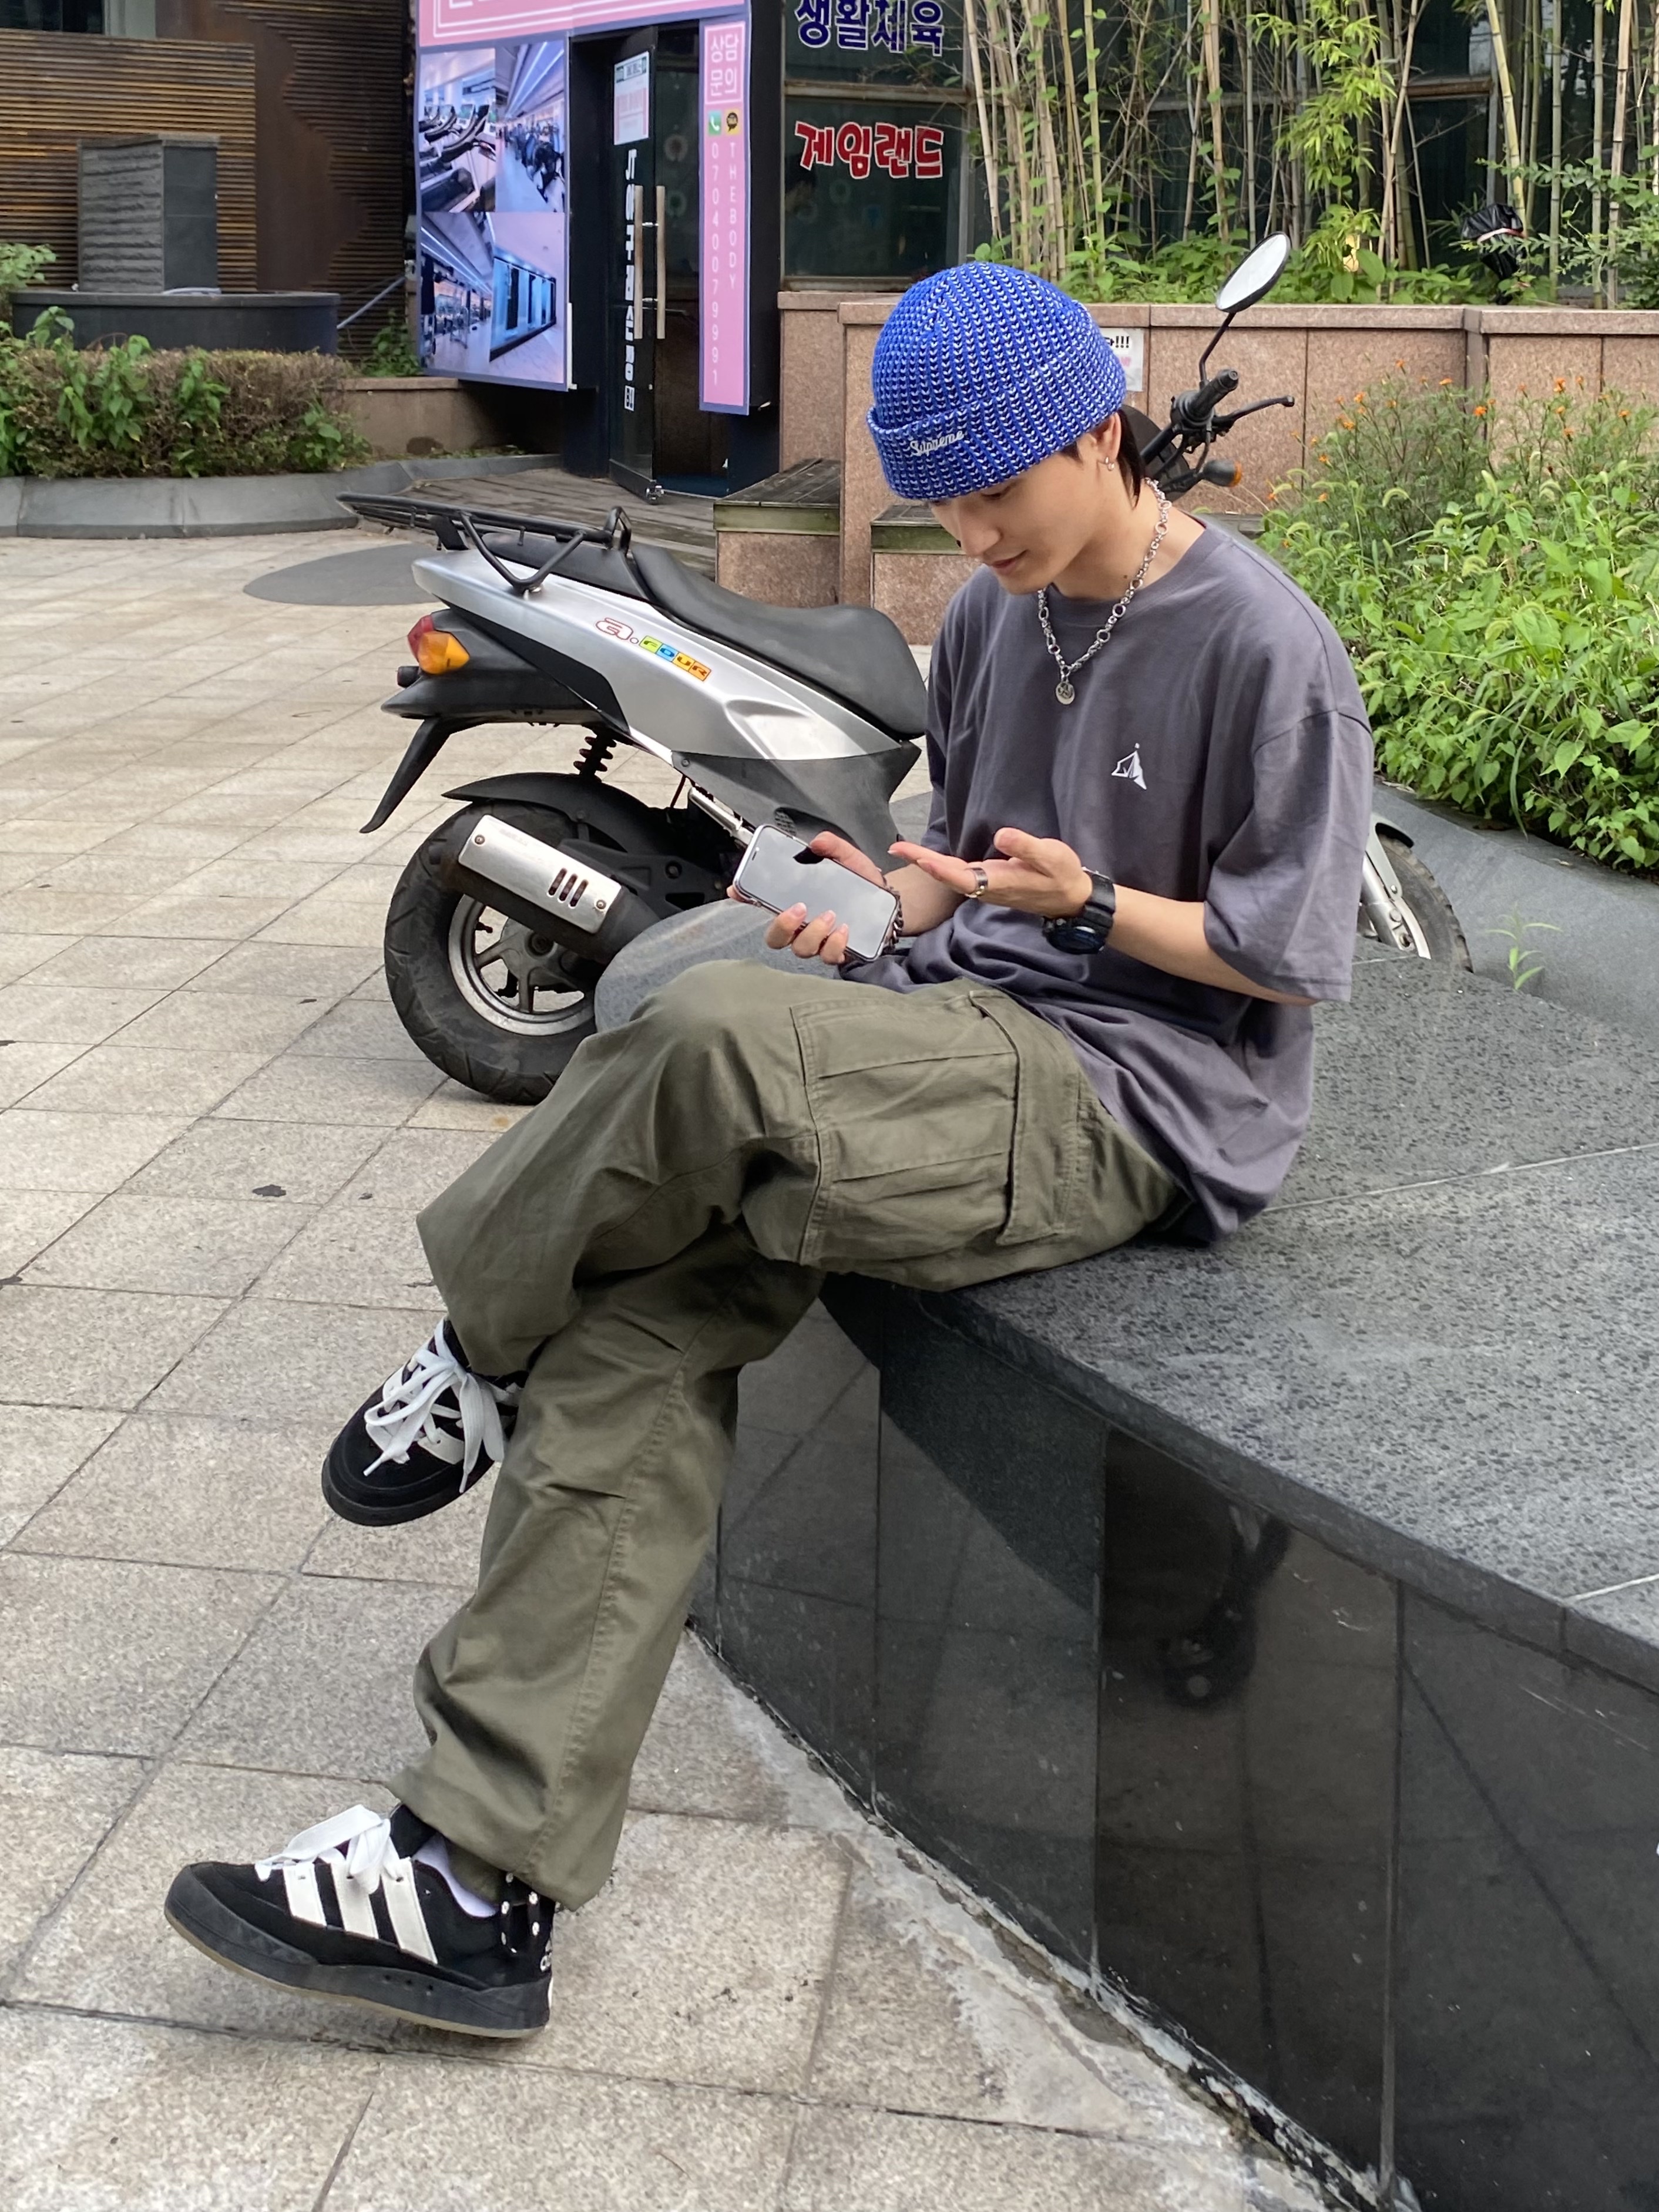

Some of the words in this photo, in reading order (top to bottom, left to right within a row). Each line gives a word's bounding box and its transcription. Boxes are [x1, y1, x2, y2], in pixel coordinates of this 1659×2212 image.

[710, 34, 739, 63] 상담
[794, 0, 944, 56] 생활체육
[710, 68, 737, 96] 문의
[795, 120, 944, 179] 게임랜드
